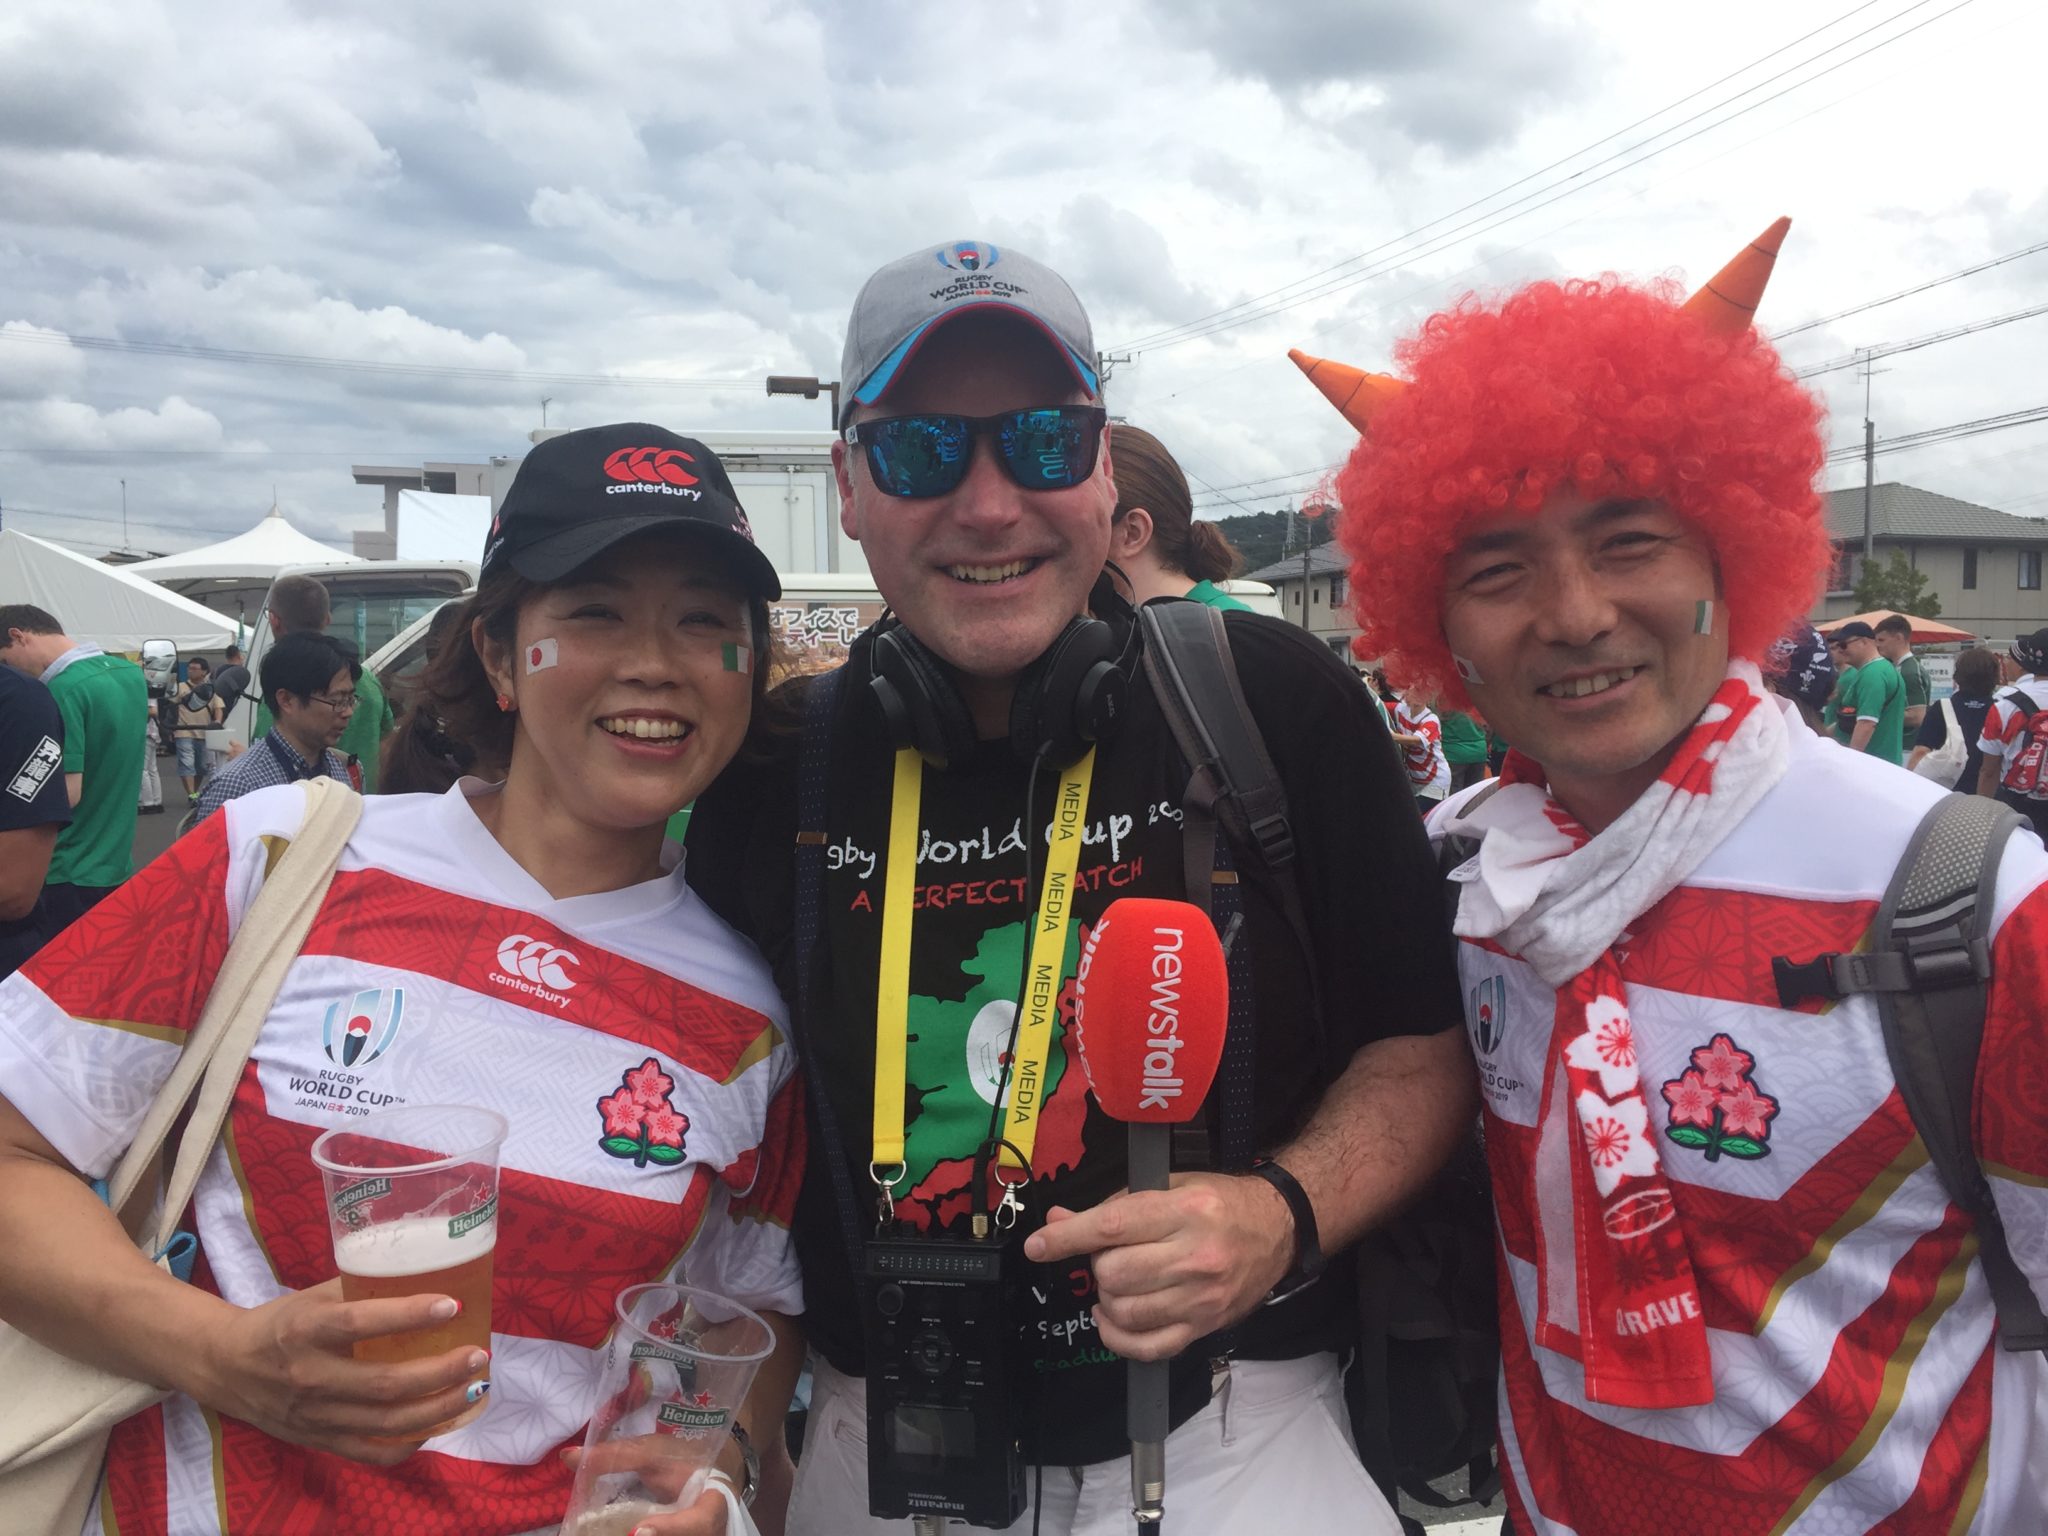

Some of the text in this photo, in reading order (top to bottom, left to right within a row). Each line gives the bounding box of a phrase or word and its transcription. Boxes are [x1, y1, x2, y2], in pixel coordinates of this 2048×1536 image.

[929, 281, 990, 299] WORLD
[954, 274, 993, 284] RUGBY
[605, 482, 702, 502] canterbury
[1058, 783, 1082, 841] MEDIA
[826, 837, 877, 879] gby
[850, 856, 1144, 912] A ERFECT ATCH
[1043, 872, 1067, 932] MEDIA
[488, 972, 572, 1009] canterbury
[1029, 964, 1053, 1027] MEDIA
[1138, 927, 1184, 1110] newstalk
[289, 1077, 353, 1100] WORLD
[319, 1069, 364, 1086] RUGBY
[1014, 1060, 1039, 1124] MEDIA
[663, 1406, 726, 1425] Heineken
[908, 1499, 964, 1510] marantz
